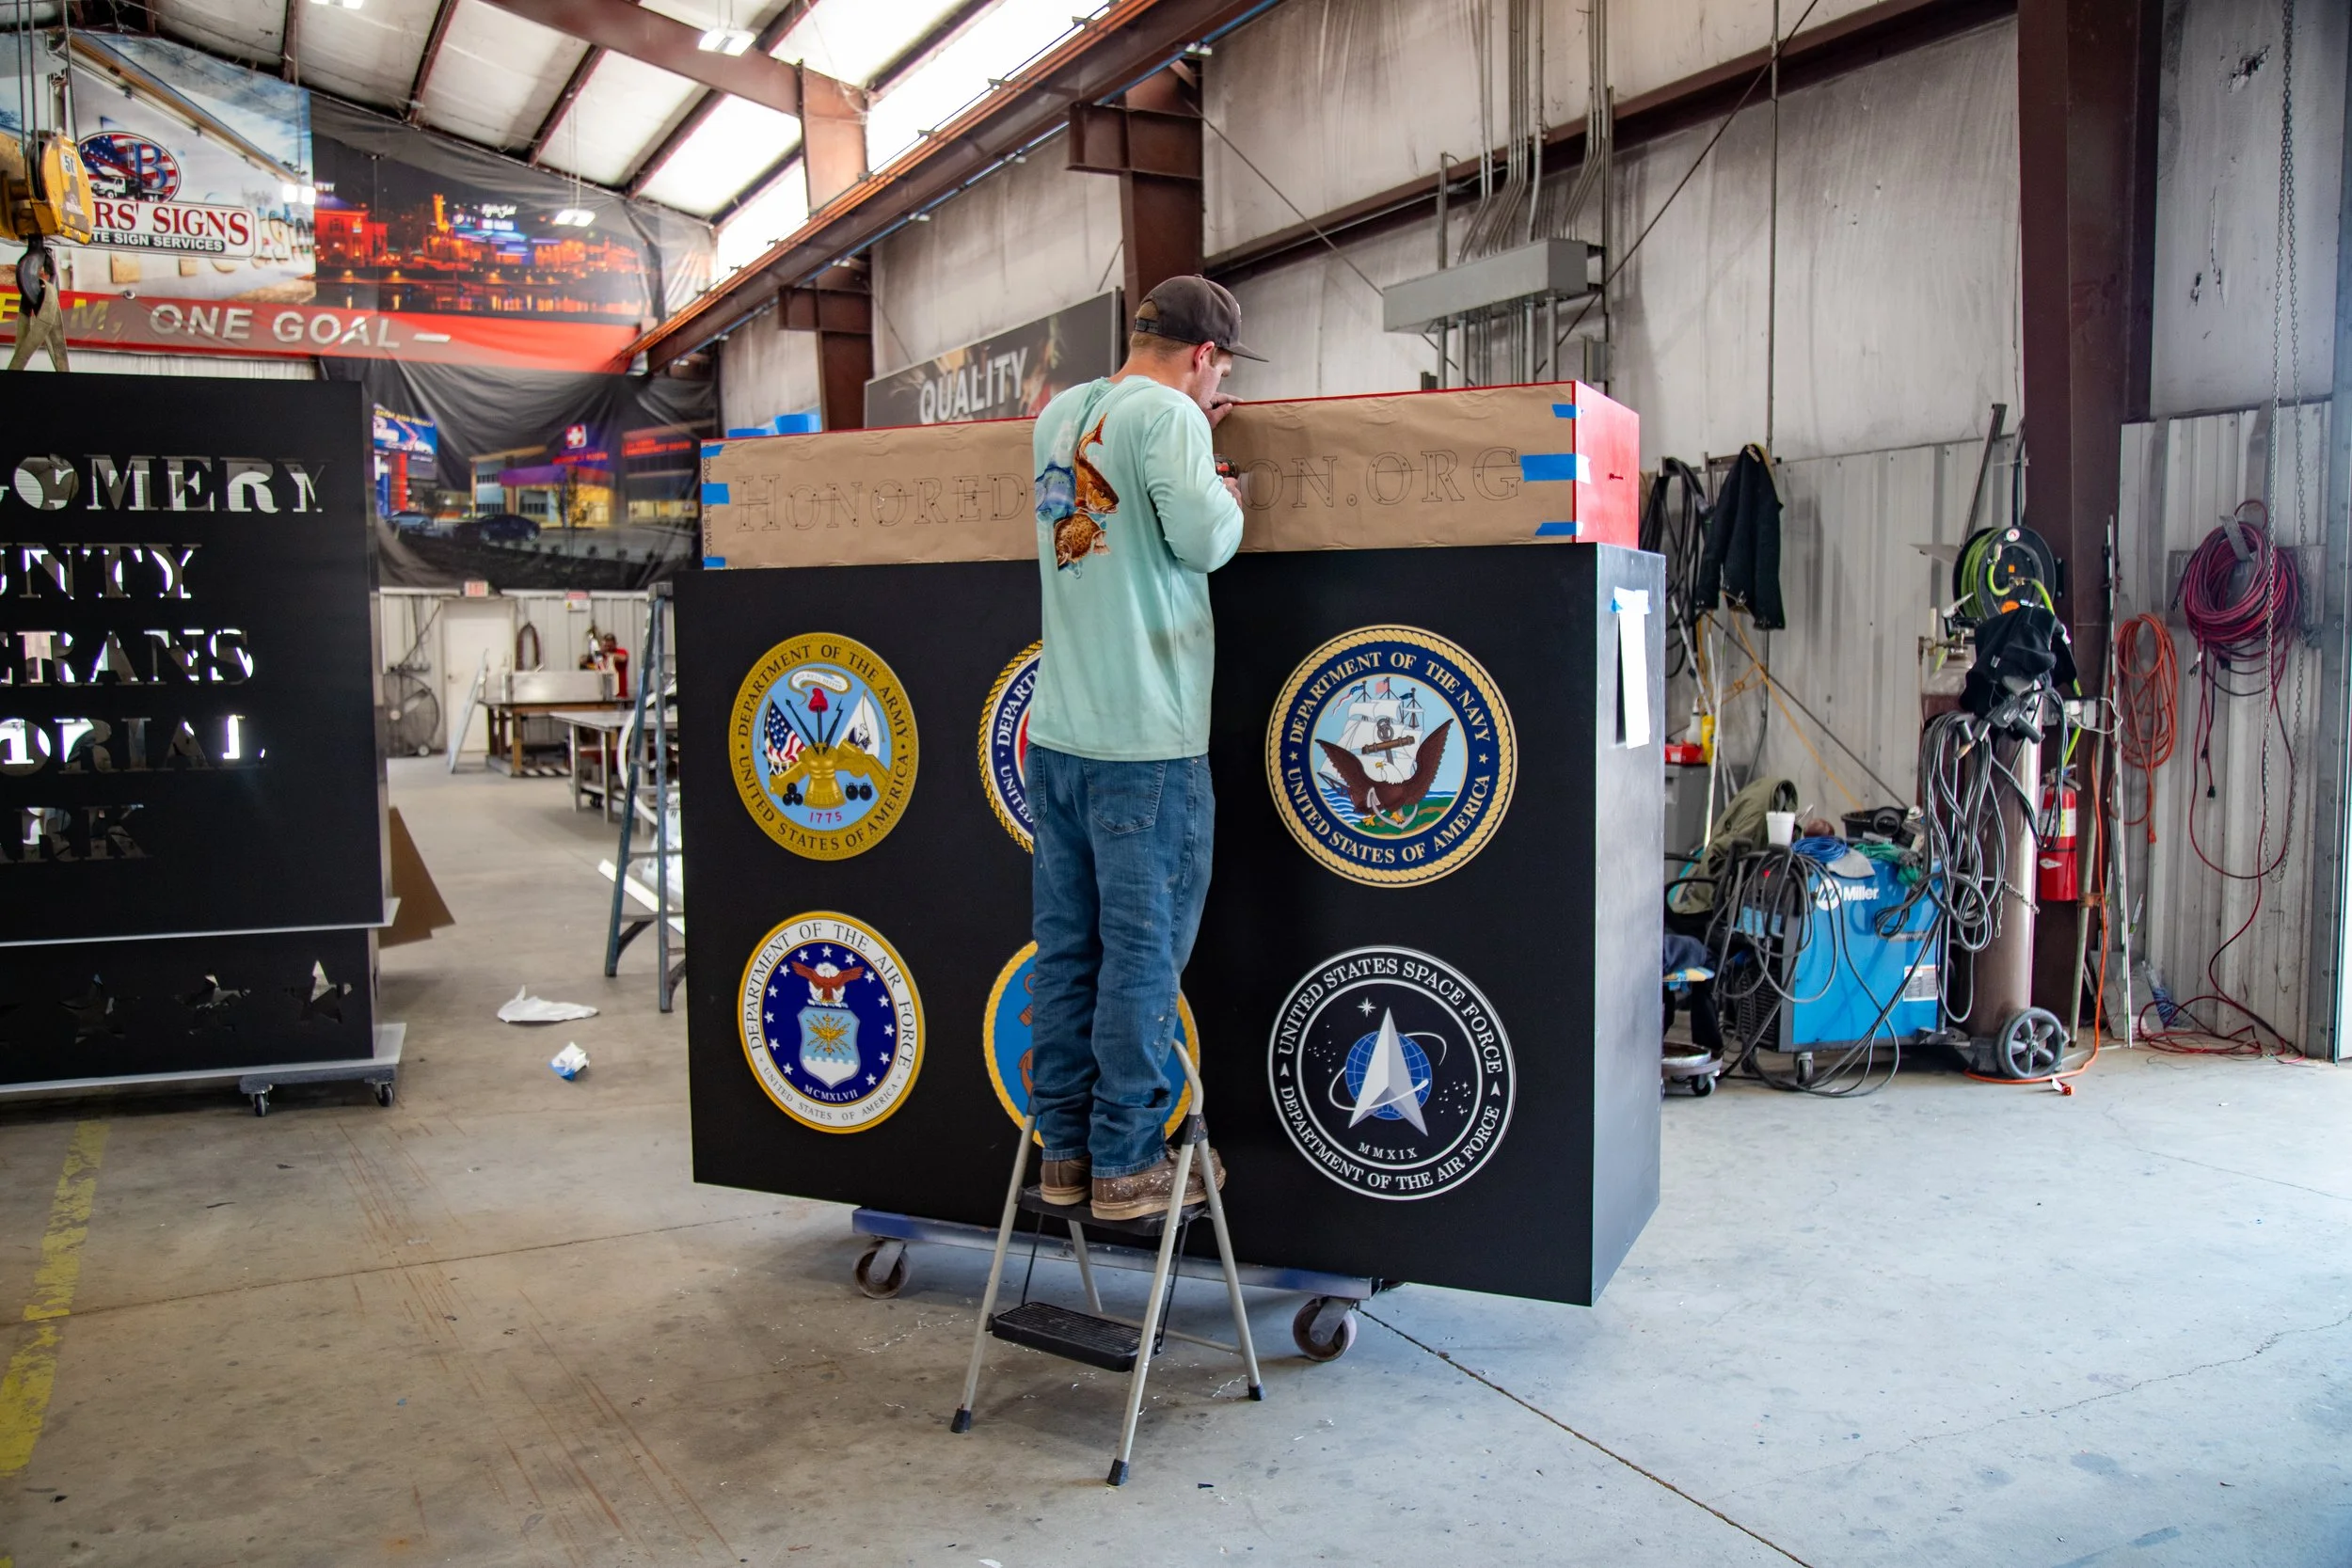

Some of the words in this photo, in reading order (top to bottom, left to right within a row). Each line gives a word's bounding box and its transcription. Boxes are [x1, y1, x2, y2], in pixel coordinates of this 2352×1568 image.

[93, 200, 139, 231] RS'
[152, 206, 249, 246] SIGNS
[93, 230, 111, 244] TE
[114, 233, 150, 246] SIGN
[152, 237, 224, 252] SERVICES
[151, 304, 253, 340] ONE
[273, 310, 401, 349] GOAL
[920, 347, 1027, 425] QUALITY
[0, 454, 332, 514] OMERY
[735, 472, 1027, 533] HONORED
[738, 644, 811, 737] DEPARTMENT
[820, 644, 842, 659] OF
[850, 652, 879, 683] THE
[879, 686, 910, 739] ARMY
[997, 670, 1038, 747] DEPART
[1289, 651, 1382, 744] DEPARTMENT
[1390, 652, 1417, 670] OF
[1426, 659, 1460, 694] THE
[1456, 689, 1491, 742] NAVY
[739, 755, 774, 824] UNITED
[777, 822, 839, 851] STATES
[845, 829, 865, 847] OF
[867, 754, 910, 835] AMERICA
[809, 812, 842, 824] 1775
[1287, 767, 1331, 836] UNITED
[1328, 832, 1395, 863] STATES
[1401, 842, 1426, 863] OF
[1433, 774, 1491, 852] AMERICA
[0, 803, 152, 863] RK
[1843, 886, 1879, 901] Miller
[746, 933, 790, 1050] DEPARTMENT
[799, 923, 822, 939] OF
[834, 924, 869, 952] THE
[873, 955, 901, 990] AIR
[898, 1001, 914, 1070] FORCE
[1278, 983, 1325, 1054] UNITED
[1323, 958, 1399, 990] STATES
[1402, 961, 1467, 1006] SPACE
[1460, 1002, 1502, 1074] FORCE
[763, 1066, 793, 1103] UNITED
[798, 1101, 833, 1120] STATES
[841, 1111, 855, 1121] OF
[861, 1083, 898, 1117] AMERICA
[803, 1085, 858, 1102] MCMXLVII
[1280, 1085, 1364, 1182] DEPARTMENT
[1367, 1172, 1392, 1189] OF
[1395, 1172, 1434, 1191] THE
[1436, 1157, 1466, 1182] AIR
[1460, 1105, 1501, 1162] FORCE
[1358, 1142, 1418, 1160] MMXIX
